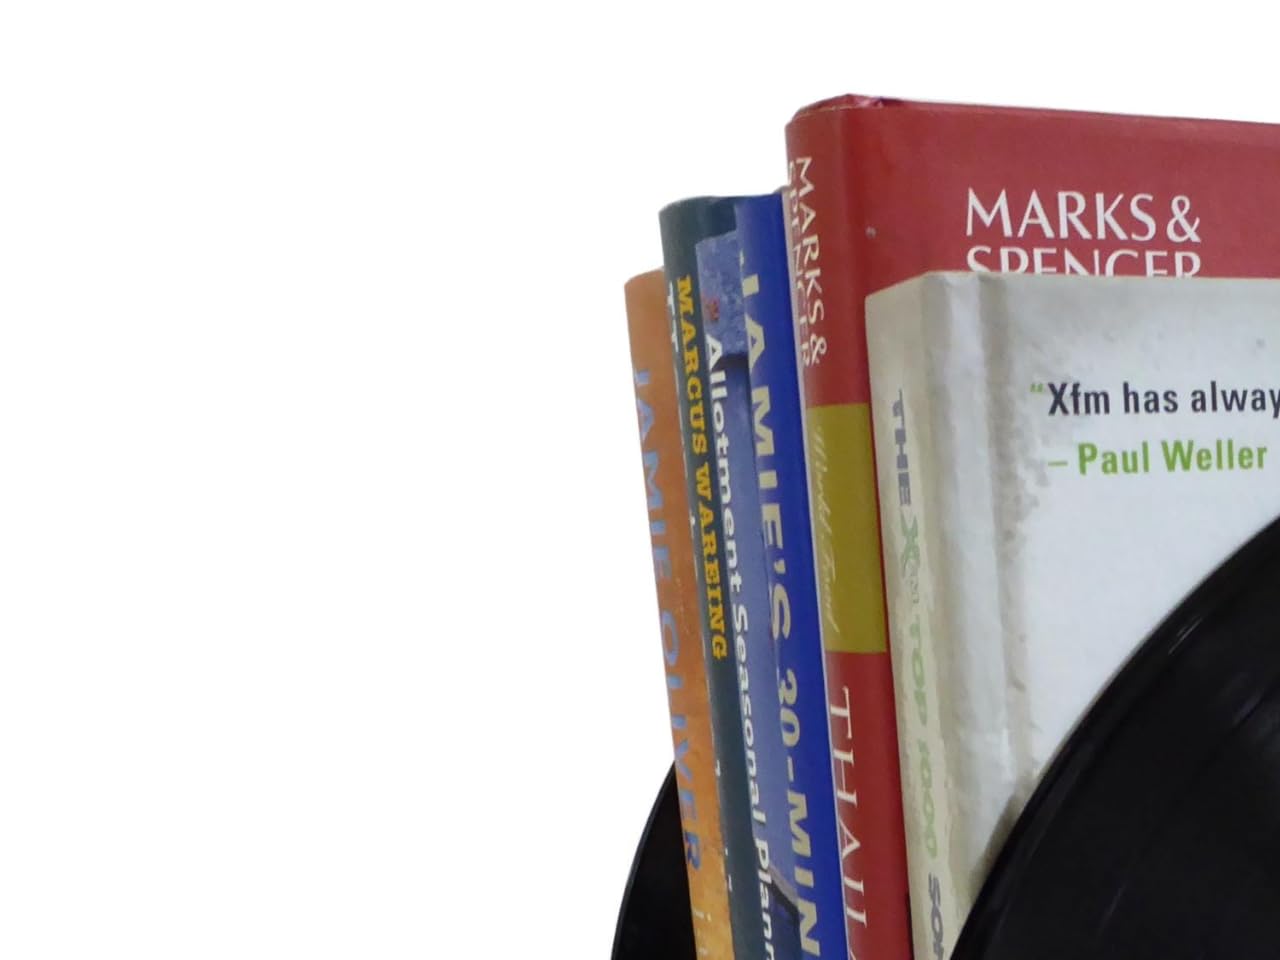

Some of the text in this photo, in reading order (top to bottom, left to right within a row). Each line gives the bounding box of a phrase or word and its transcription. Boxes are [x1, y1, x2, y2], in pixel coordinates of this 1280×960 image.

[796, 156, 828, 368] MARKS &
[965, 187, 1201, 243] MARKS &
[676, 274, 728, 660] MARCUS WAREING
[739, 248, 791, 640] JAMIE'S
[892, 388, 911, 506] THE
[1078, 440, 1150, 475] Paul
[1161, 439, 1268, 472] Weller
[1122, 381, 1179, 414] has
[635, 368, 702, 870] JAMIE OLIVER
[705, 333, 742, 593] Allotment
[732, 603, 767, 825] Seasonal
